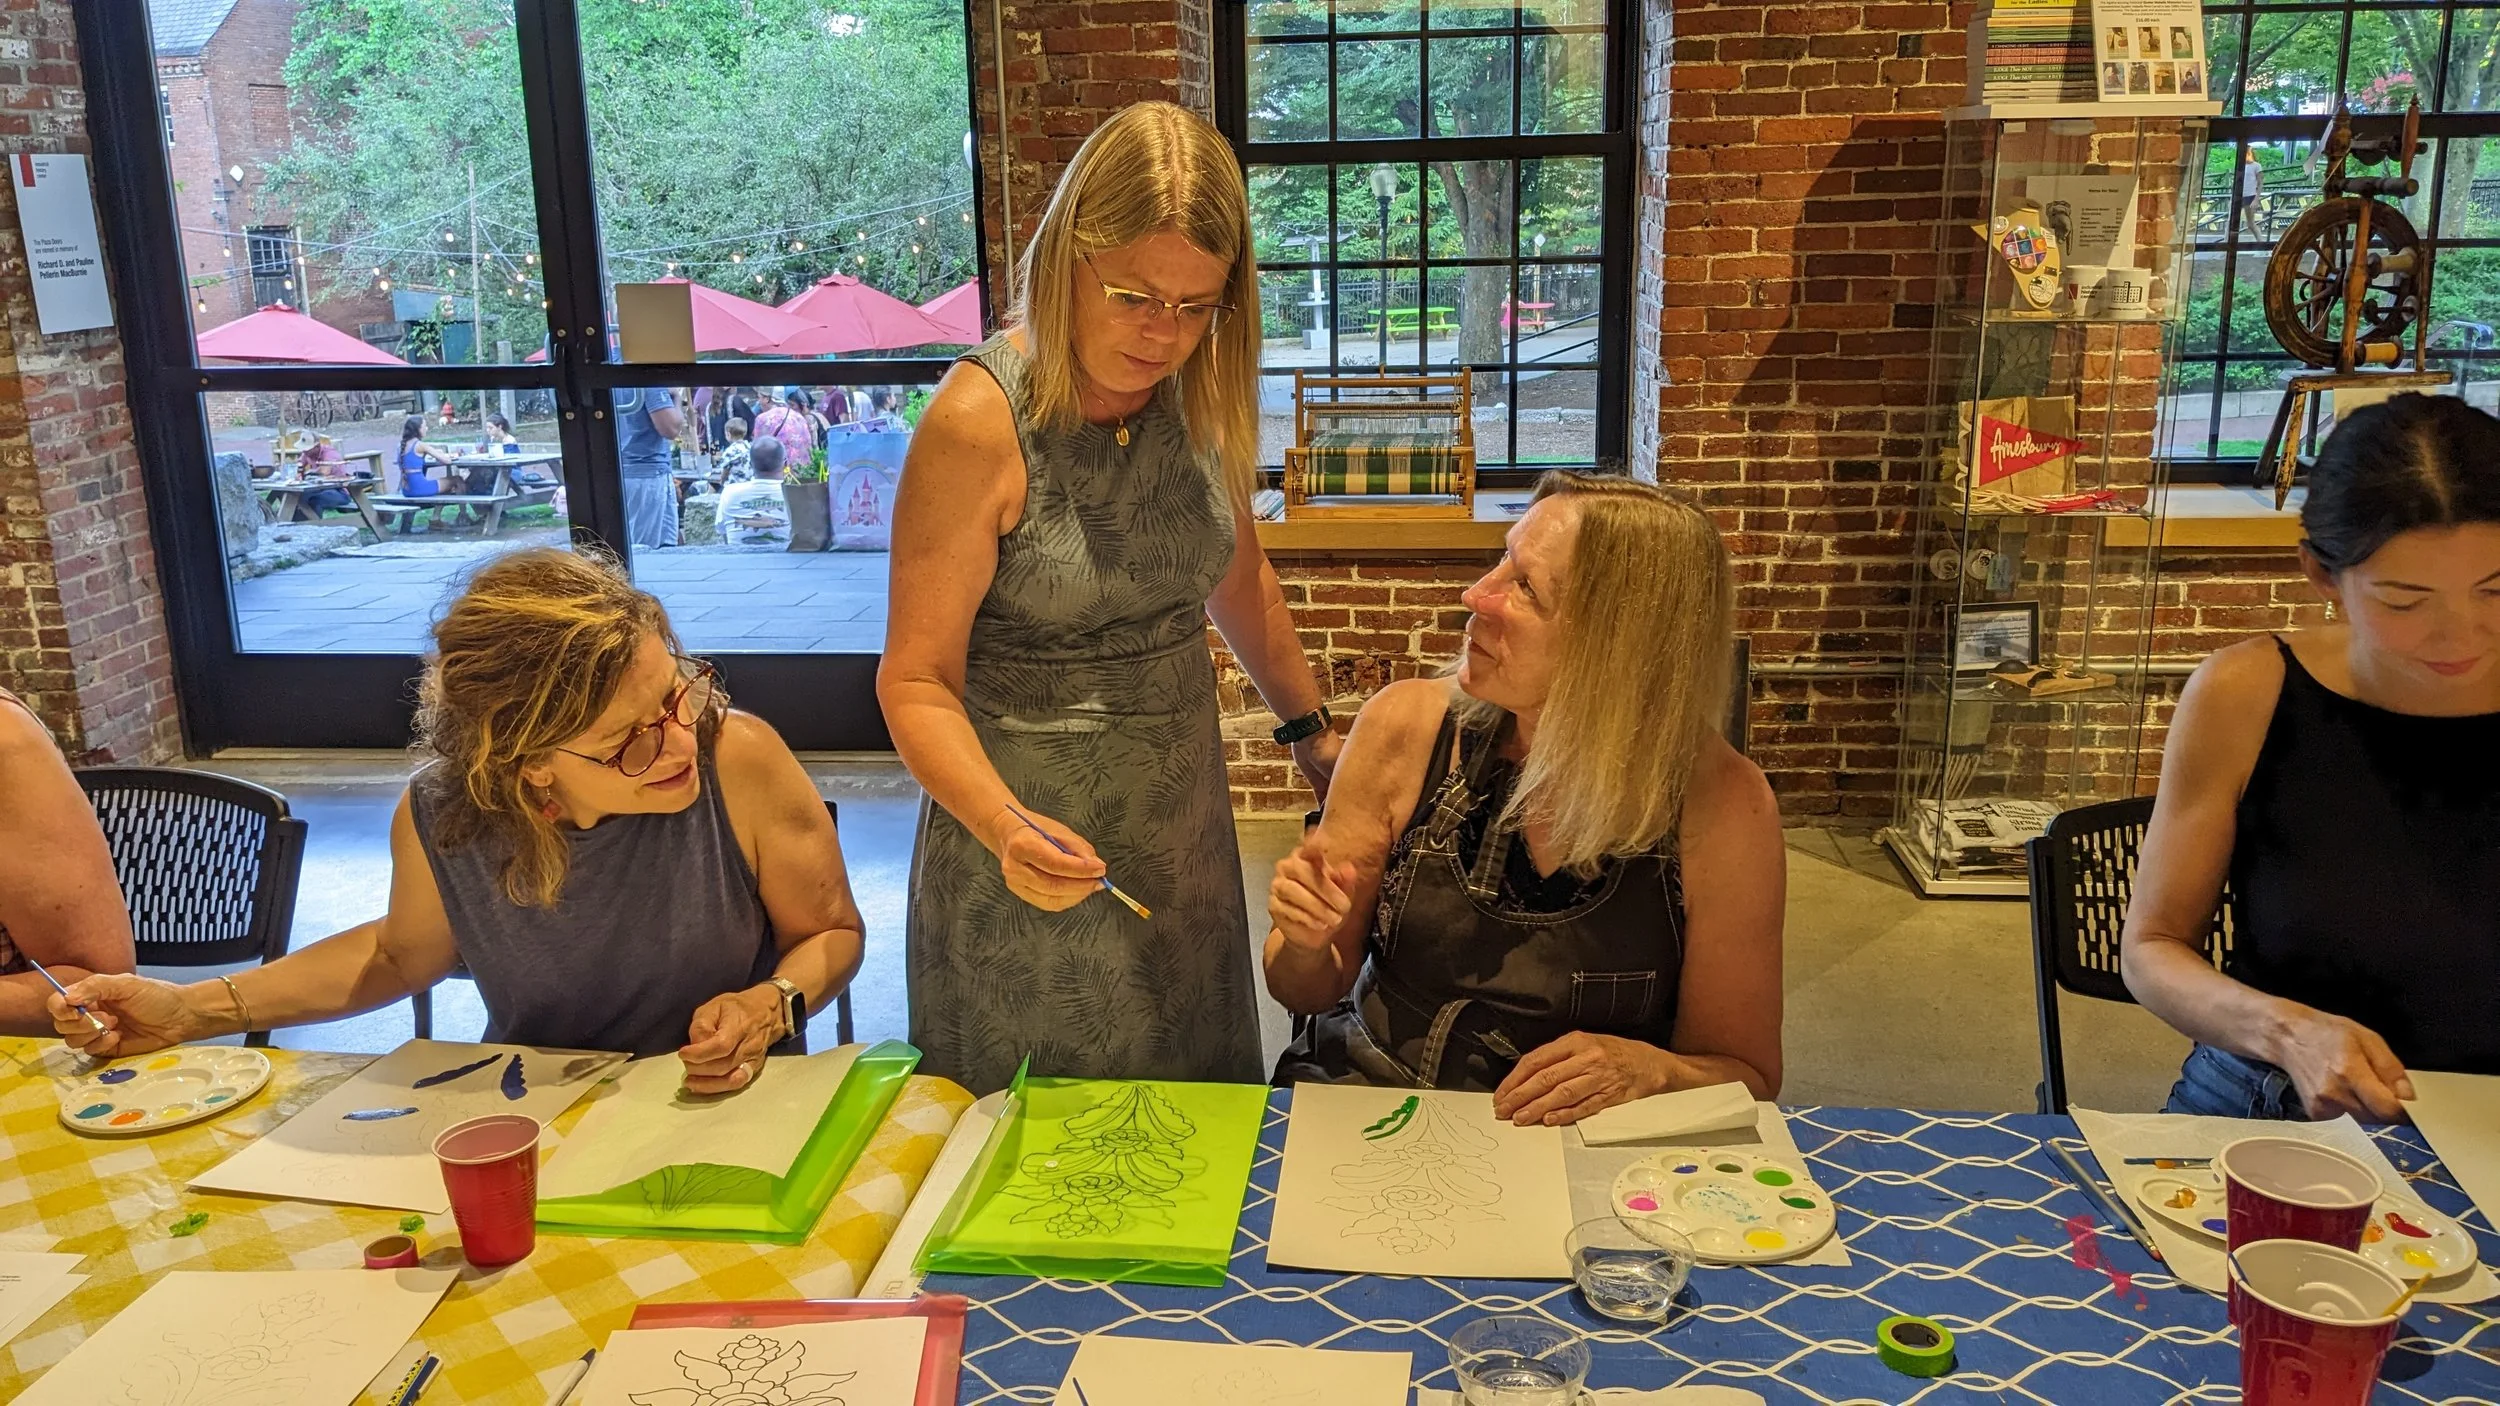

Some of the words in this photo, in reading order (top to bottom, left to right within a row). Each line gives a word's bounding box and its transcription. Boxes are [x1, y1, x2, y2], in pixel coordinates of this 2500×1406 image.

[38, 260, 58, 269] Richard
[65, 259, 75, 267] and
[75, 257, 95, 266] Pauline
[1990, 427, 2061, 472] Amesbury
